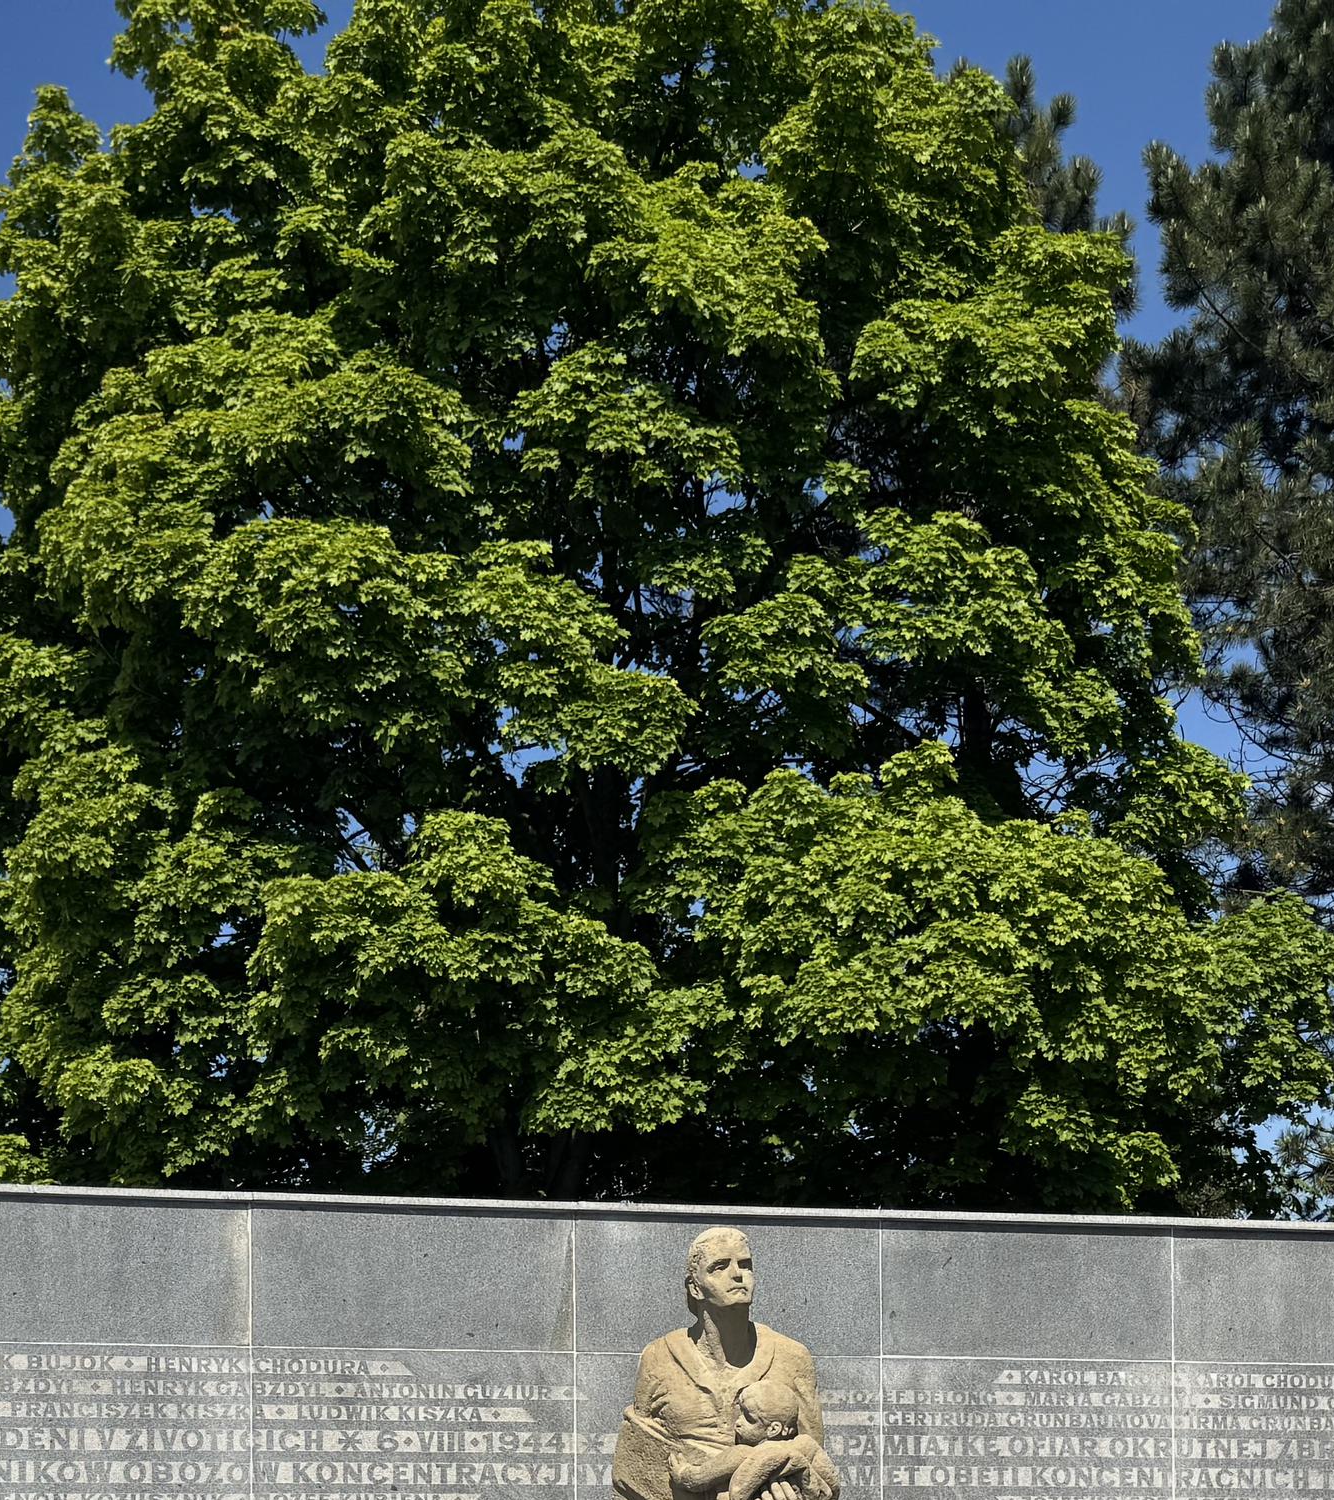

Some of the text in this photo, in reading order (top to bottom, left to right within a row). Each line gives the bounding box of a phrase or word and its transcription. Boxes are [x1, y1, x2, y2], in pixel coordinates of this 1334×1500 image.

[27, 1355, 112, 1372] BUJOK
[146, 1357, 242, 1374] HENRYK
[254, 1359, 370, 1376] CHODURA
[1020, 1370, 1090, 1386] KAROL
[112, 1379, 209, 1396] HENRYK
[216, 1381, 326, 1398] GABZDYL
[354, 1383, 455, 1400] ANTONIN
[463, 1384, 552, 1401] GUZIUR
[915, 1390, 996, 1406] DELONG
[1025, 1392, 1091, 1408] MARIA
[1219, 1395, 1318, 1411] SIGMUND
[11, 1401, 167, 1419] FRANCISZEK
[176, 1403, 265, 1420] KISZKA
[297, 1405, 389, 1422] LUDWIK
[398, 1406, 482, 1423] KISZKA
[884, 1412, 997, 1428] GERTRUDA
[1189, 1415, 1239, 1431] IRMA
[95, 1427, 115, 1451] V
[376, 1430, 399, 1453] 6
[416, 1431, 465, 1454] VIII
[482, 1431, 564, 1454] 1944
[1007, 1436, 1097, 1458] OFIAR
[1108, 1437, 1267, 1460] OKRUTNEJ
[293, 1462, 609, 1486] KONCENTRACYJNY
